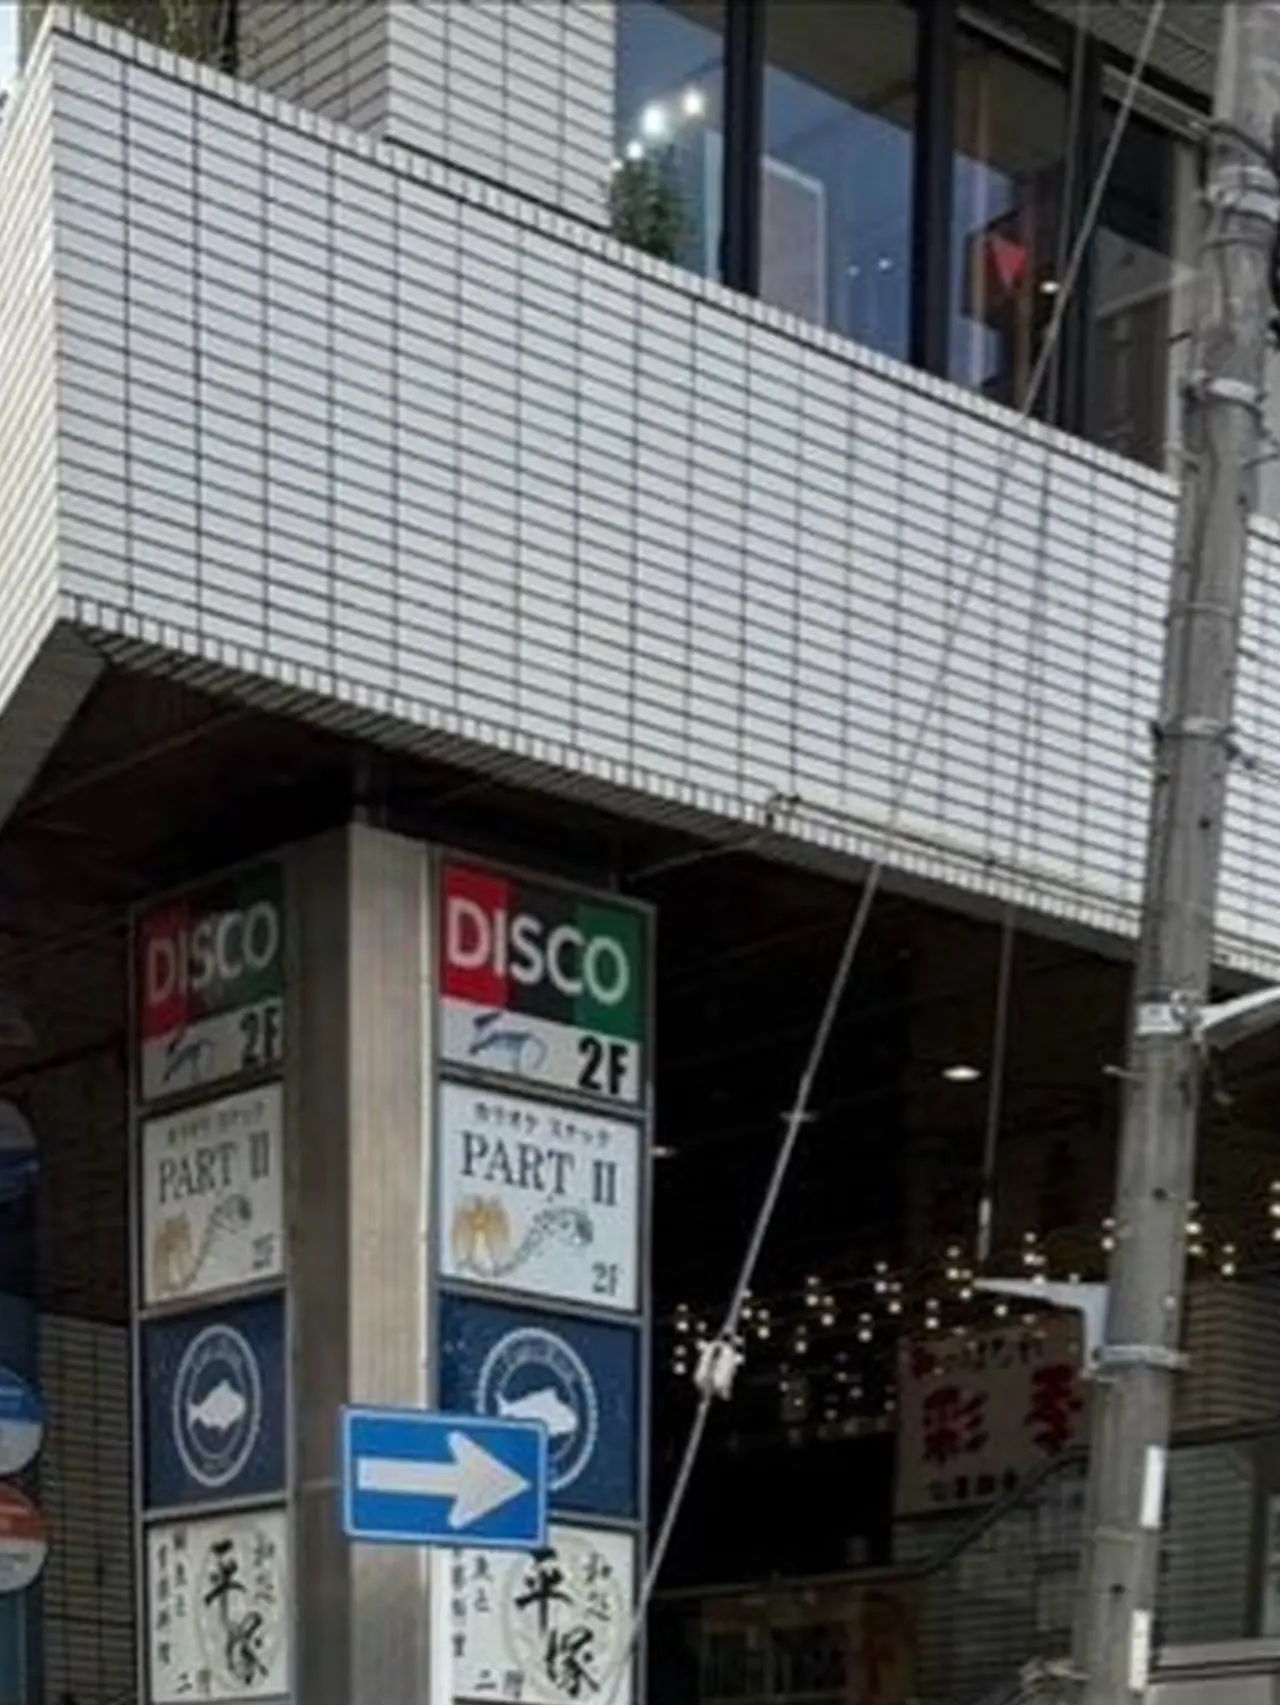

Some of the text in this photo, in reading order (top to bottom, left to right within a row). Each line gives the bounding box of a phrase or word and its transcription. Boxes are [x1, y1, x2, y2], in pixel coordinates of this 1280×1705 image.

[147, 901, 279, 1006] DISCO
[447, 895, 631, 1008] DISCO
[577, 1033, 628, 1095] 2F
[158, 1139, 240, 1206] PART
[459, 1129, 577, 1196] PART
